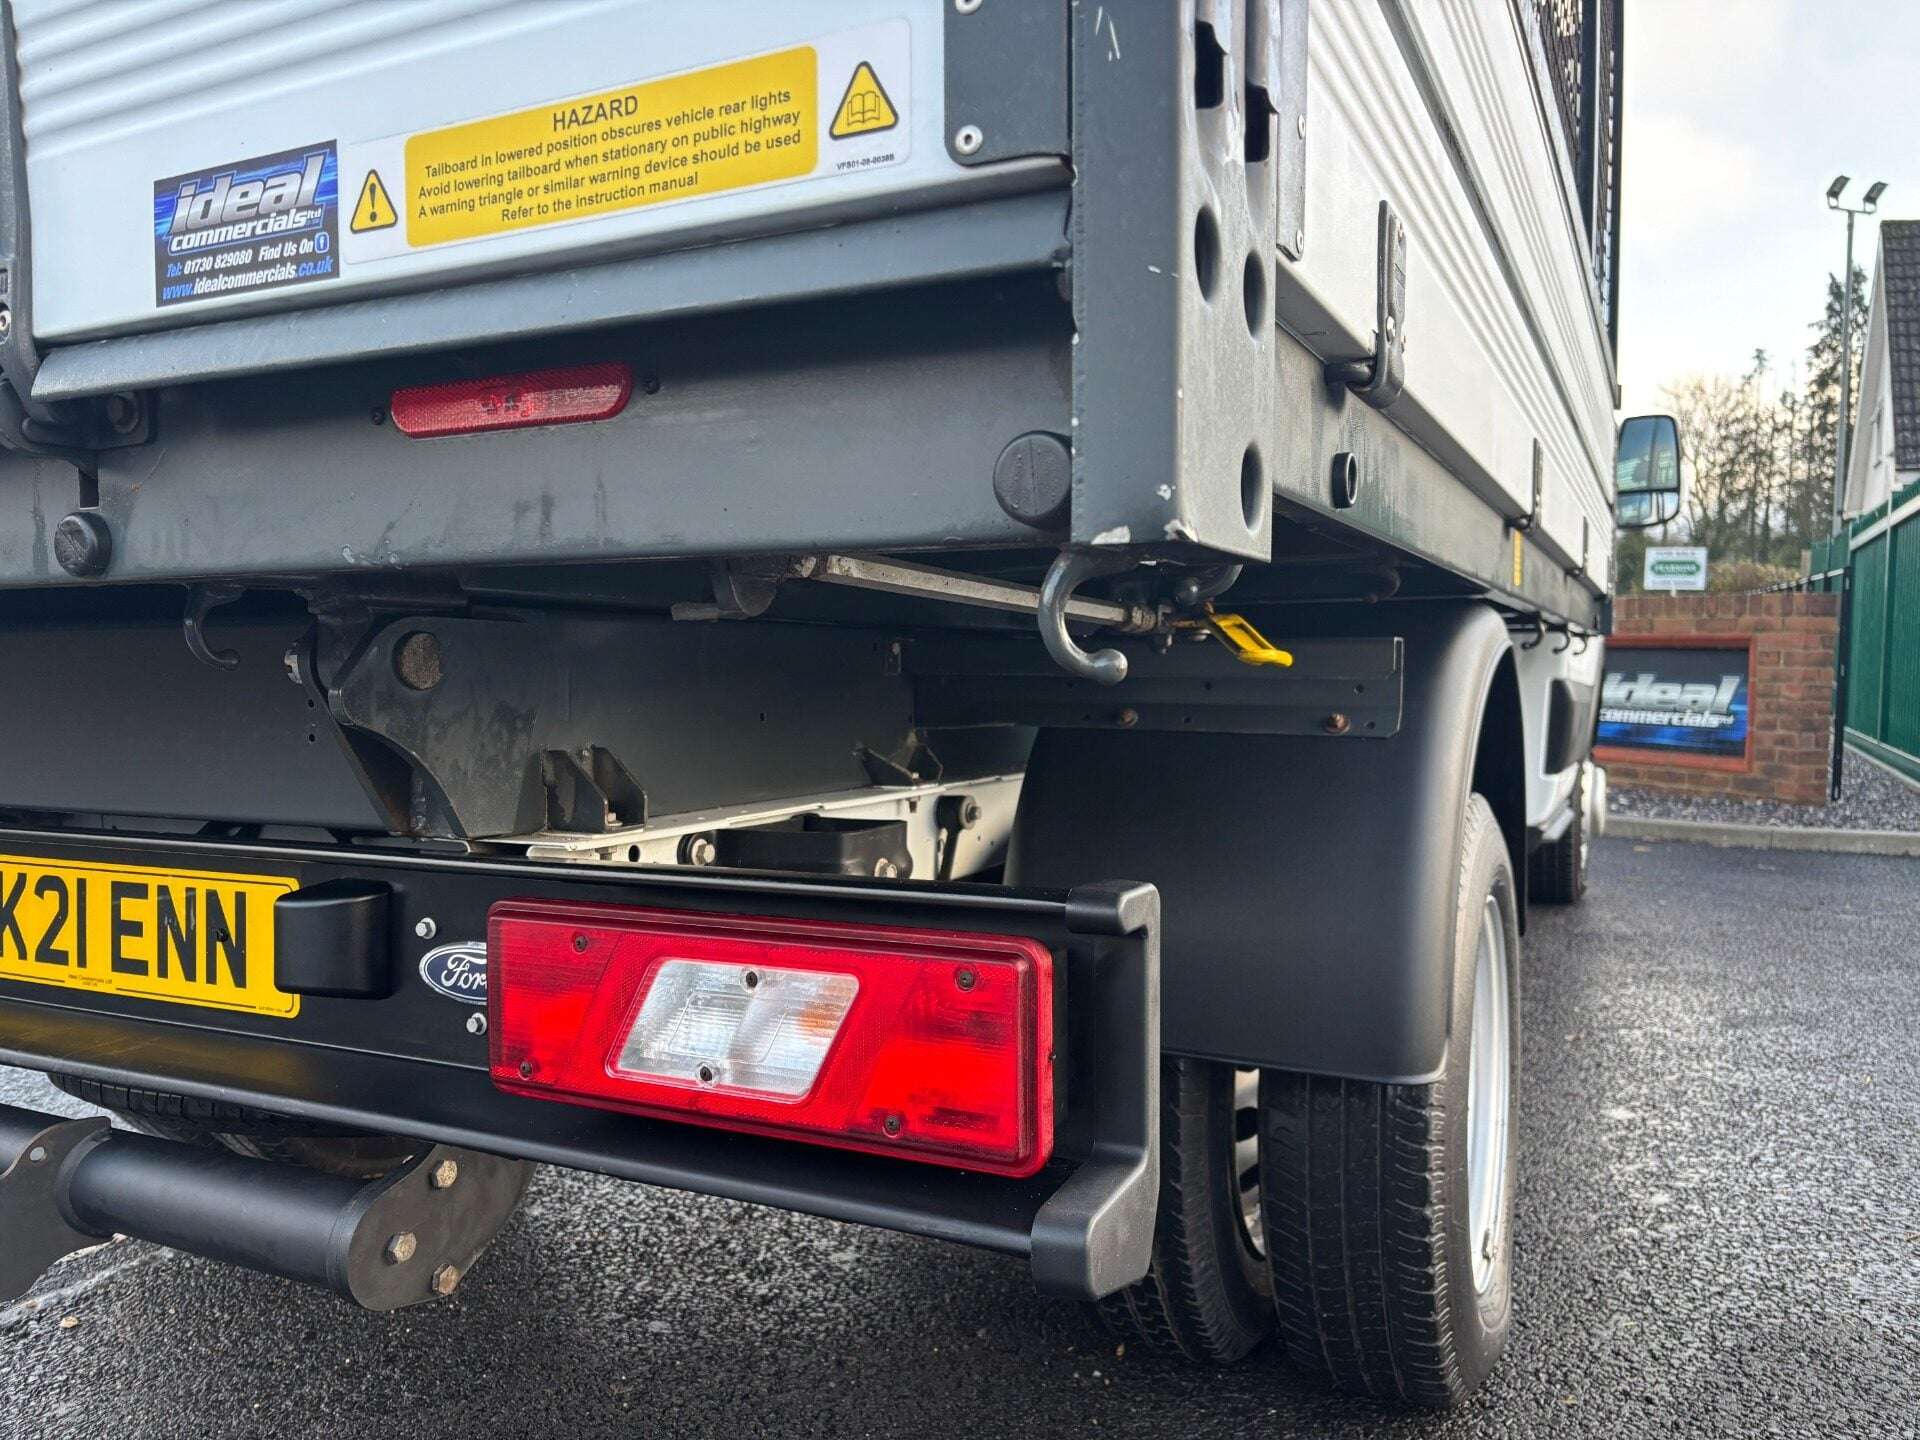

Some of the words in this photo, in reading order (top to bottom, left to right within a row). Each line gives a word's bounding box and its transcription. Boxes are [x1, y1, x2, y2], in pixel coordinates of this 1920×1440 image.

[425, 156, 477, 179] Tailboard
[481, 153, 492, 166] in
[495, 142, 543, 164] lowered
[547, 133, 597, 156] position
[601, 118, 661, 142] obscures
[666, 106, 714, 128] vehicle
[719, 100, 746, 116] rear
[751, 90, 791, 110] lights
[553, 96, 638, 131] HAZARD
[418, 182, 450, 199] Avoid
[454, 172, 503, 191] lowering
[507, 159, 561, 181] tailboard
[564, 153, 598, 169] when
[602, 138, 667, 163] stationary
[671, 135, 689, 149] on
[693, 124, 736, 151] public
[740, 111, 801, 135] highway
[418, 205, 427, 218] A
[430, 197, 475, 216] warning
[479, 187, 523, 206] triangle
[527, 186, 539, 196] or
[543, 176, 586, 194] similar
[588, 159, 640, 185] warning
[644, 153, 688, 176] device
[692, 144, 740, 165] should
[744, 140, 762, 155] be
[765, 130, 801, 150] used
[170, 154, 326, 234] ideal
[501, 205, 534, 222] Refer
[537, 202, 549, 215] to
[553, 197, 572, 213] the
[576, 185, 645, 209] instruction
[649, 172, 698, 195] manual
[171, 208, 307, 253] commercials
[184, 256, 213, 275] 01730
[214, 249, 253, 270] 829080
[258, 243, 282, 262] Find
[283, 241, 297, 257] Us
[299, 238, 314, 255] On
[162, 256, 334, 301] www.idealcommercials.co.uk
[111, 880, 247, 990] ENN
